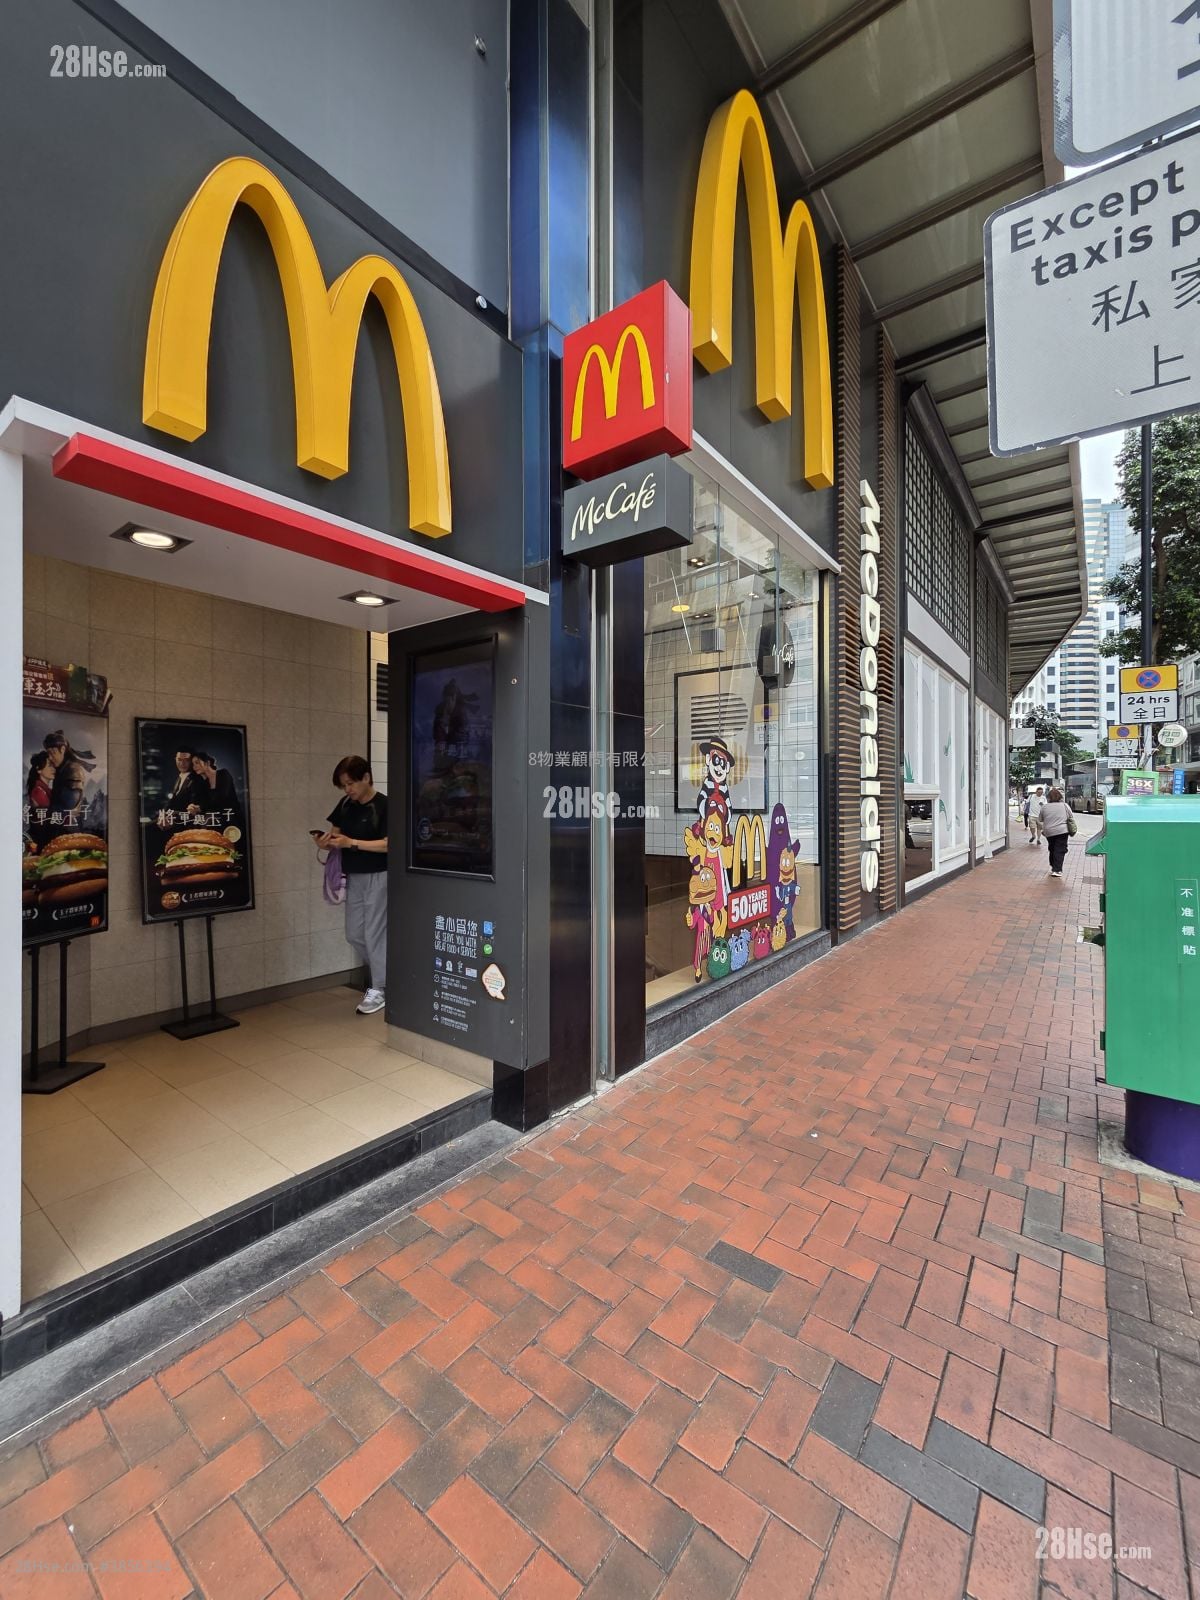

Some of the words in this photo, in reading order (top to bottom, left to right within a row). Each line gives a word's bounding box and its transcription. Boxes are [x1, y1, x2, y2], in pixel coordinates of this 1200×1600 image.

[1011, 160, 1184, 253] Except
[1031, 225, 1153, 286] taxis
[1130, 344, 1191, 396] 上
[571, 472, 656, 541] McCafé
[1127, 696, 1145, 706] 24
[1149, 695, 1171, 704] hrs
[1133, 707, 1166, 720] 全日
[731, 895, 748, 923] 50
[748, 890, 765, 903] YEARS
